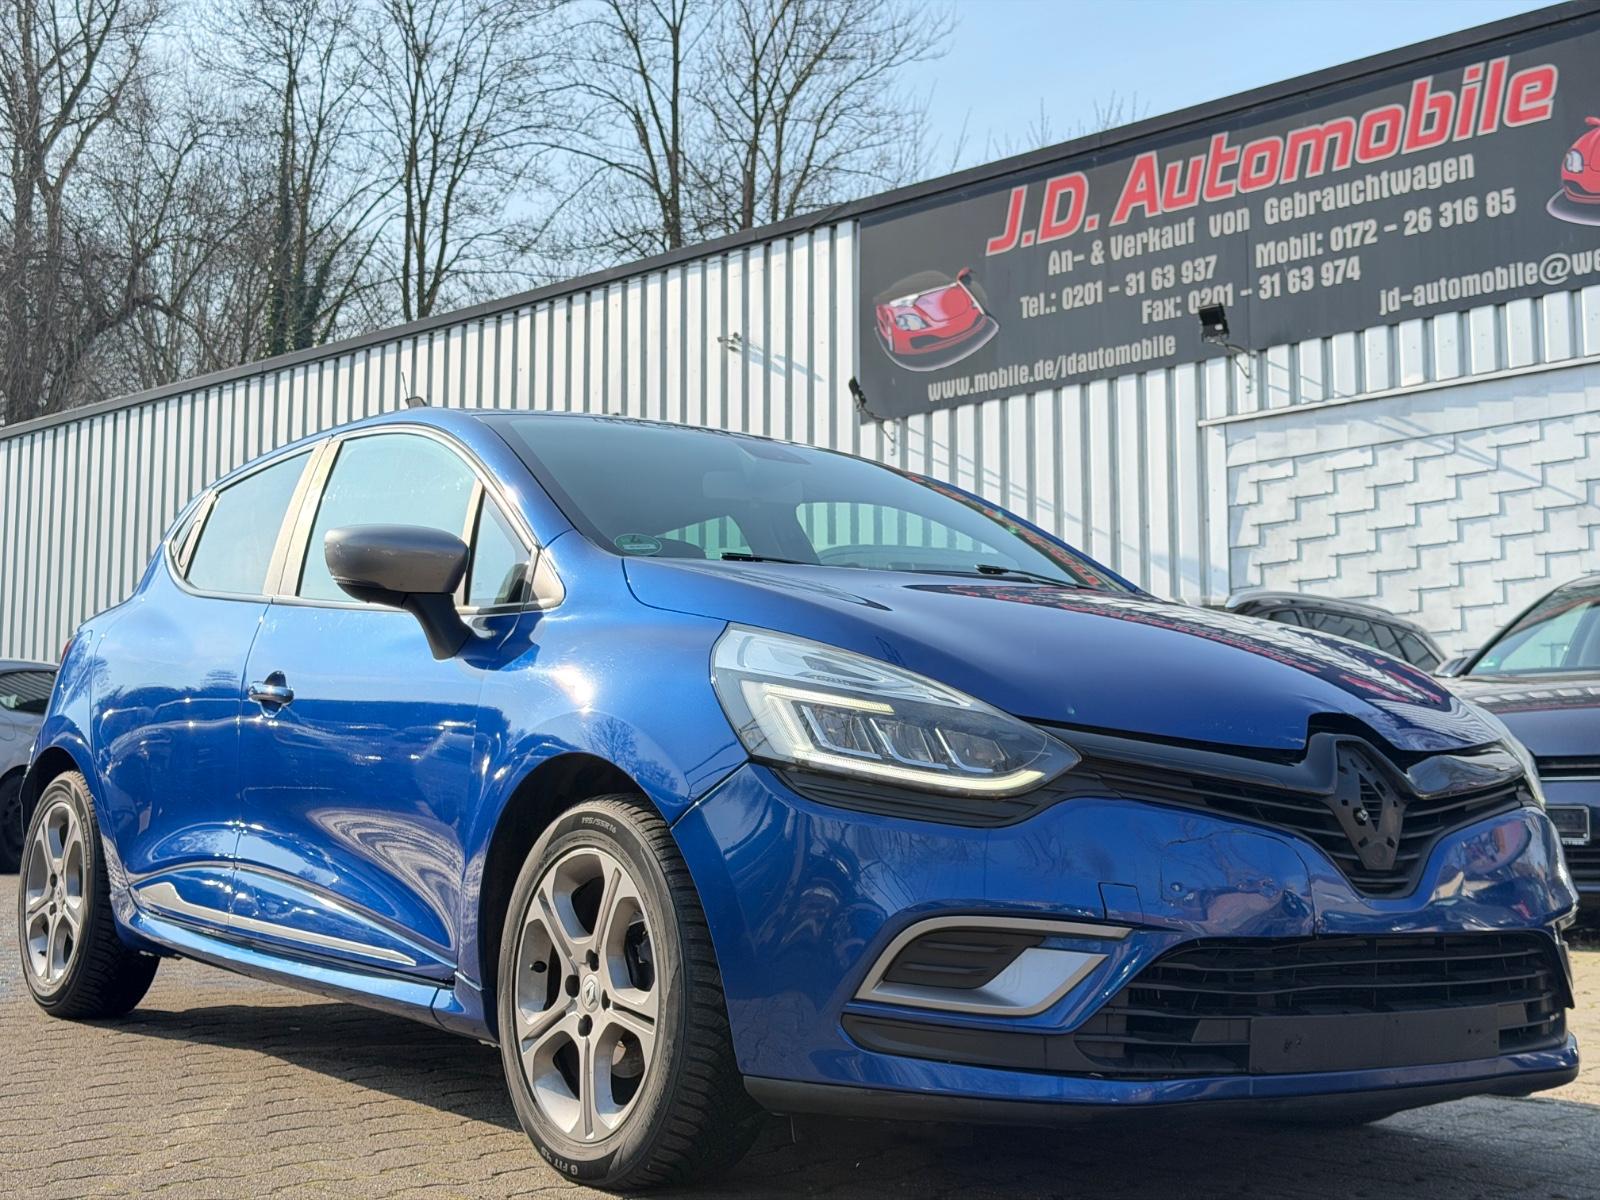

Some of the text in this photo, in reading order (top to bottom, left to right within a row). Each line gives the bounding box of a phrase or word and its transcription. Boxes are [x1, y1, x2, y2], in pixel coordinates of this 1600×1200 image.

[986, 56, 1558, 256] J.D. Automobile
[1048, 153, 1475, 275] An- & Verkauf von Gebrauchtwagen
[1255, 231, 1324, 269] Mobil:
[1330, 218, 1378, 252] 0172
[1403, 206, 1432, 236] 26
[1439, 197, 1478, 229] 316
[1486, 188, 1516, 218] 85
[1020, 291, 1056, 318] Tel.:
[1062, 280, 1103, 311] 0201
[1125, 270, 1145, 296] 31
[1151, 264, 1175, 291] 63
[1181, 254, 1217, 284] 937
[1141, 295, 1182, 324] Fax:
[1258, 272, 1280, 300] 31
[1287, 265, 1314, 294] 63
[1320, 256, 1361, 288] 974
[927, 334, 1176, 402] www.mobile.de/jdautomobile
